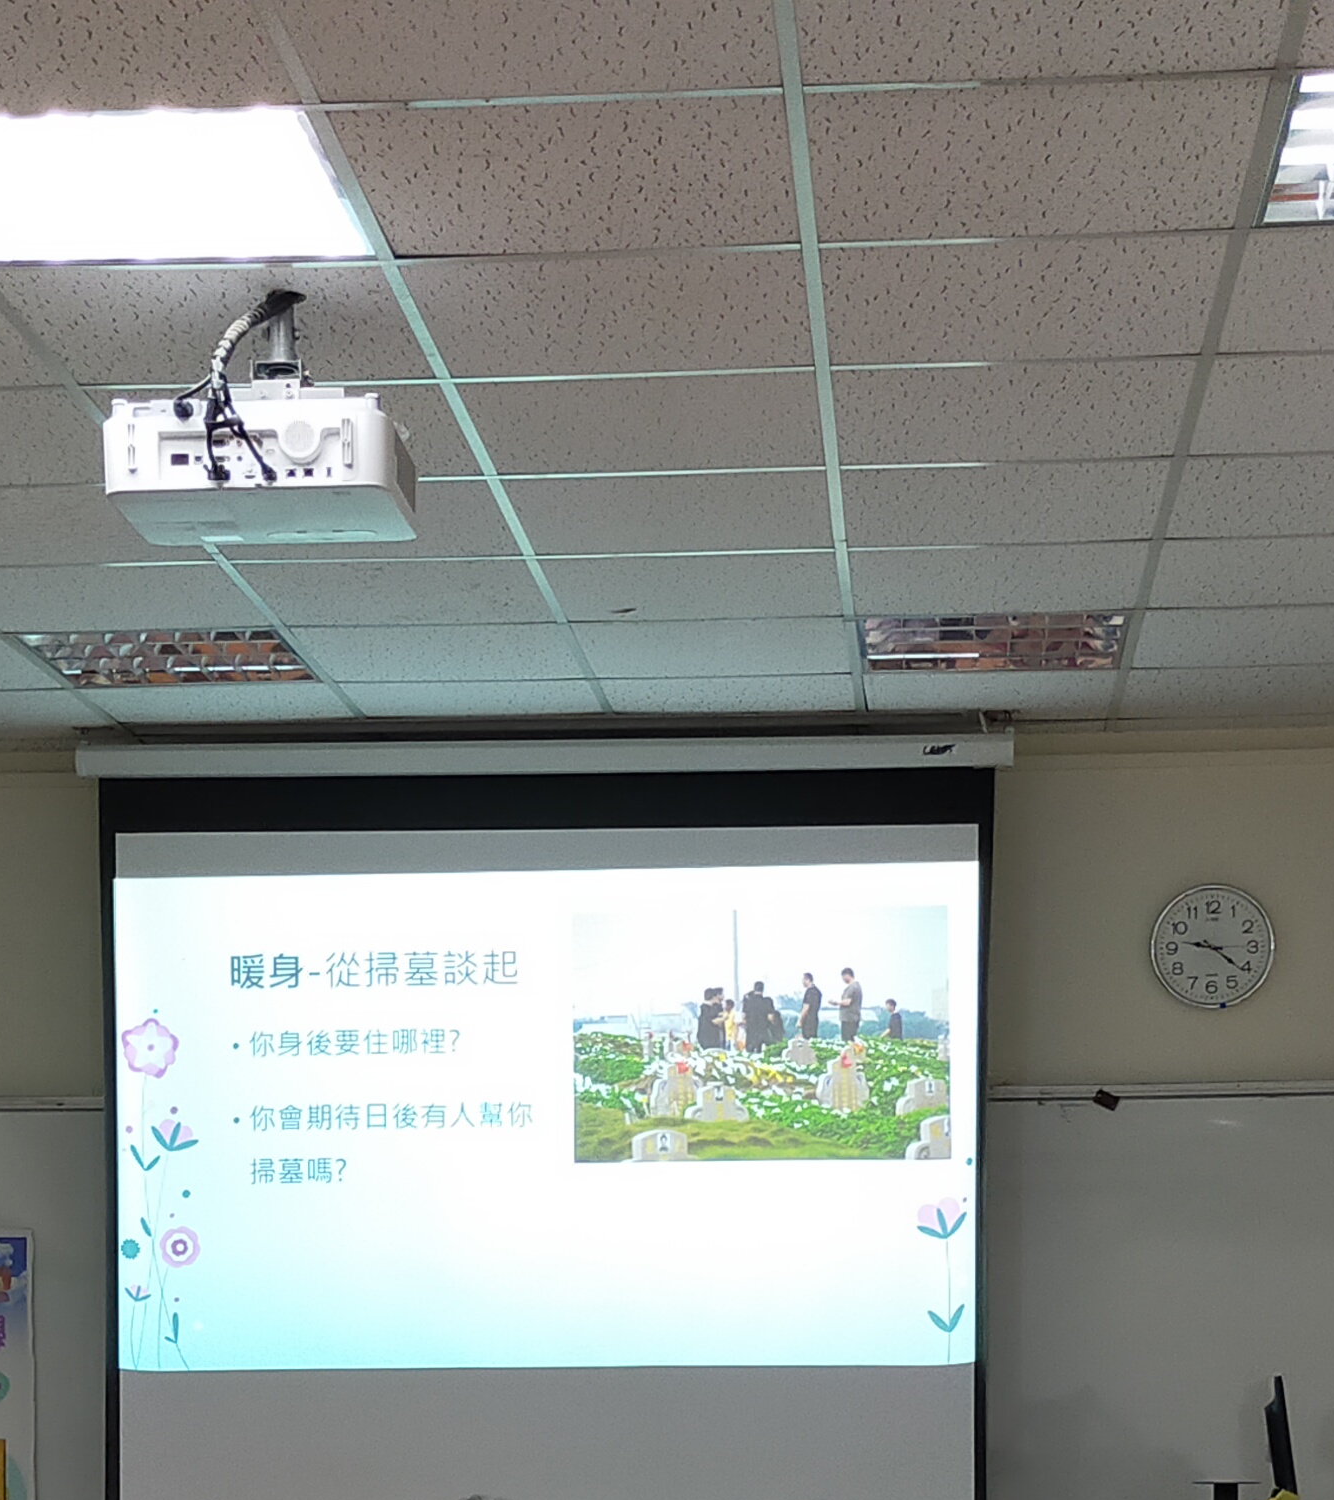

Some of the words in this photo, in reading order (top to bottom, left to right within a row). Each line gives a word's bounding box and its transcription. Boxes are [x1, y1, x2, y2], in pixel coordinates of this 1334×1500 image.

[1187, 906, 1198, 919] 11
[1205, 900, 1221, 914] 12
[1230, 905, 1236, 918] 1
[1171, 921, 1188, 935] 10
[1242, 920, 1254, 934] 2
[1165, 942, 1178, 955] 9
[1247, 940, 1259, 954] 3
[230, 950, 518, 989] 暖身-從掃墓談起
[1172, 962, 1184, 975] 8
[1241, 961, 1252, 974] 4
[1187, 976, 1198, 990] 7
[1205, 980, 1218, 994] 6
[1226, 975, 1238, 989] 5
[249, 1029, 461, 1057] 你身後要住哪裡?
[249, 1101, 533, 1131] 你會期待日後有人幫你
[249, 1157, 347, 1185] 掃墓嗎?
